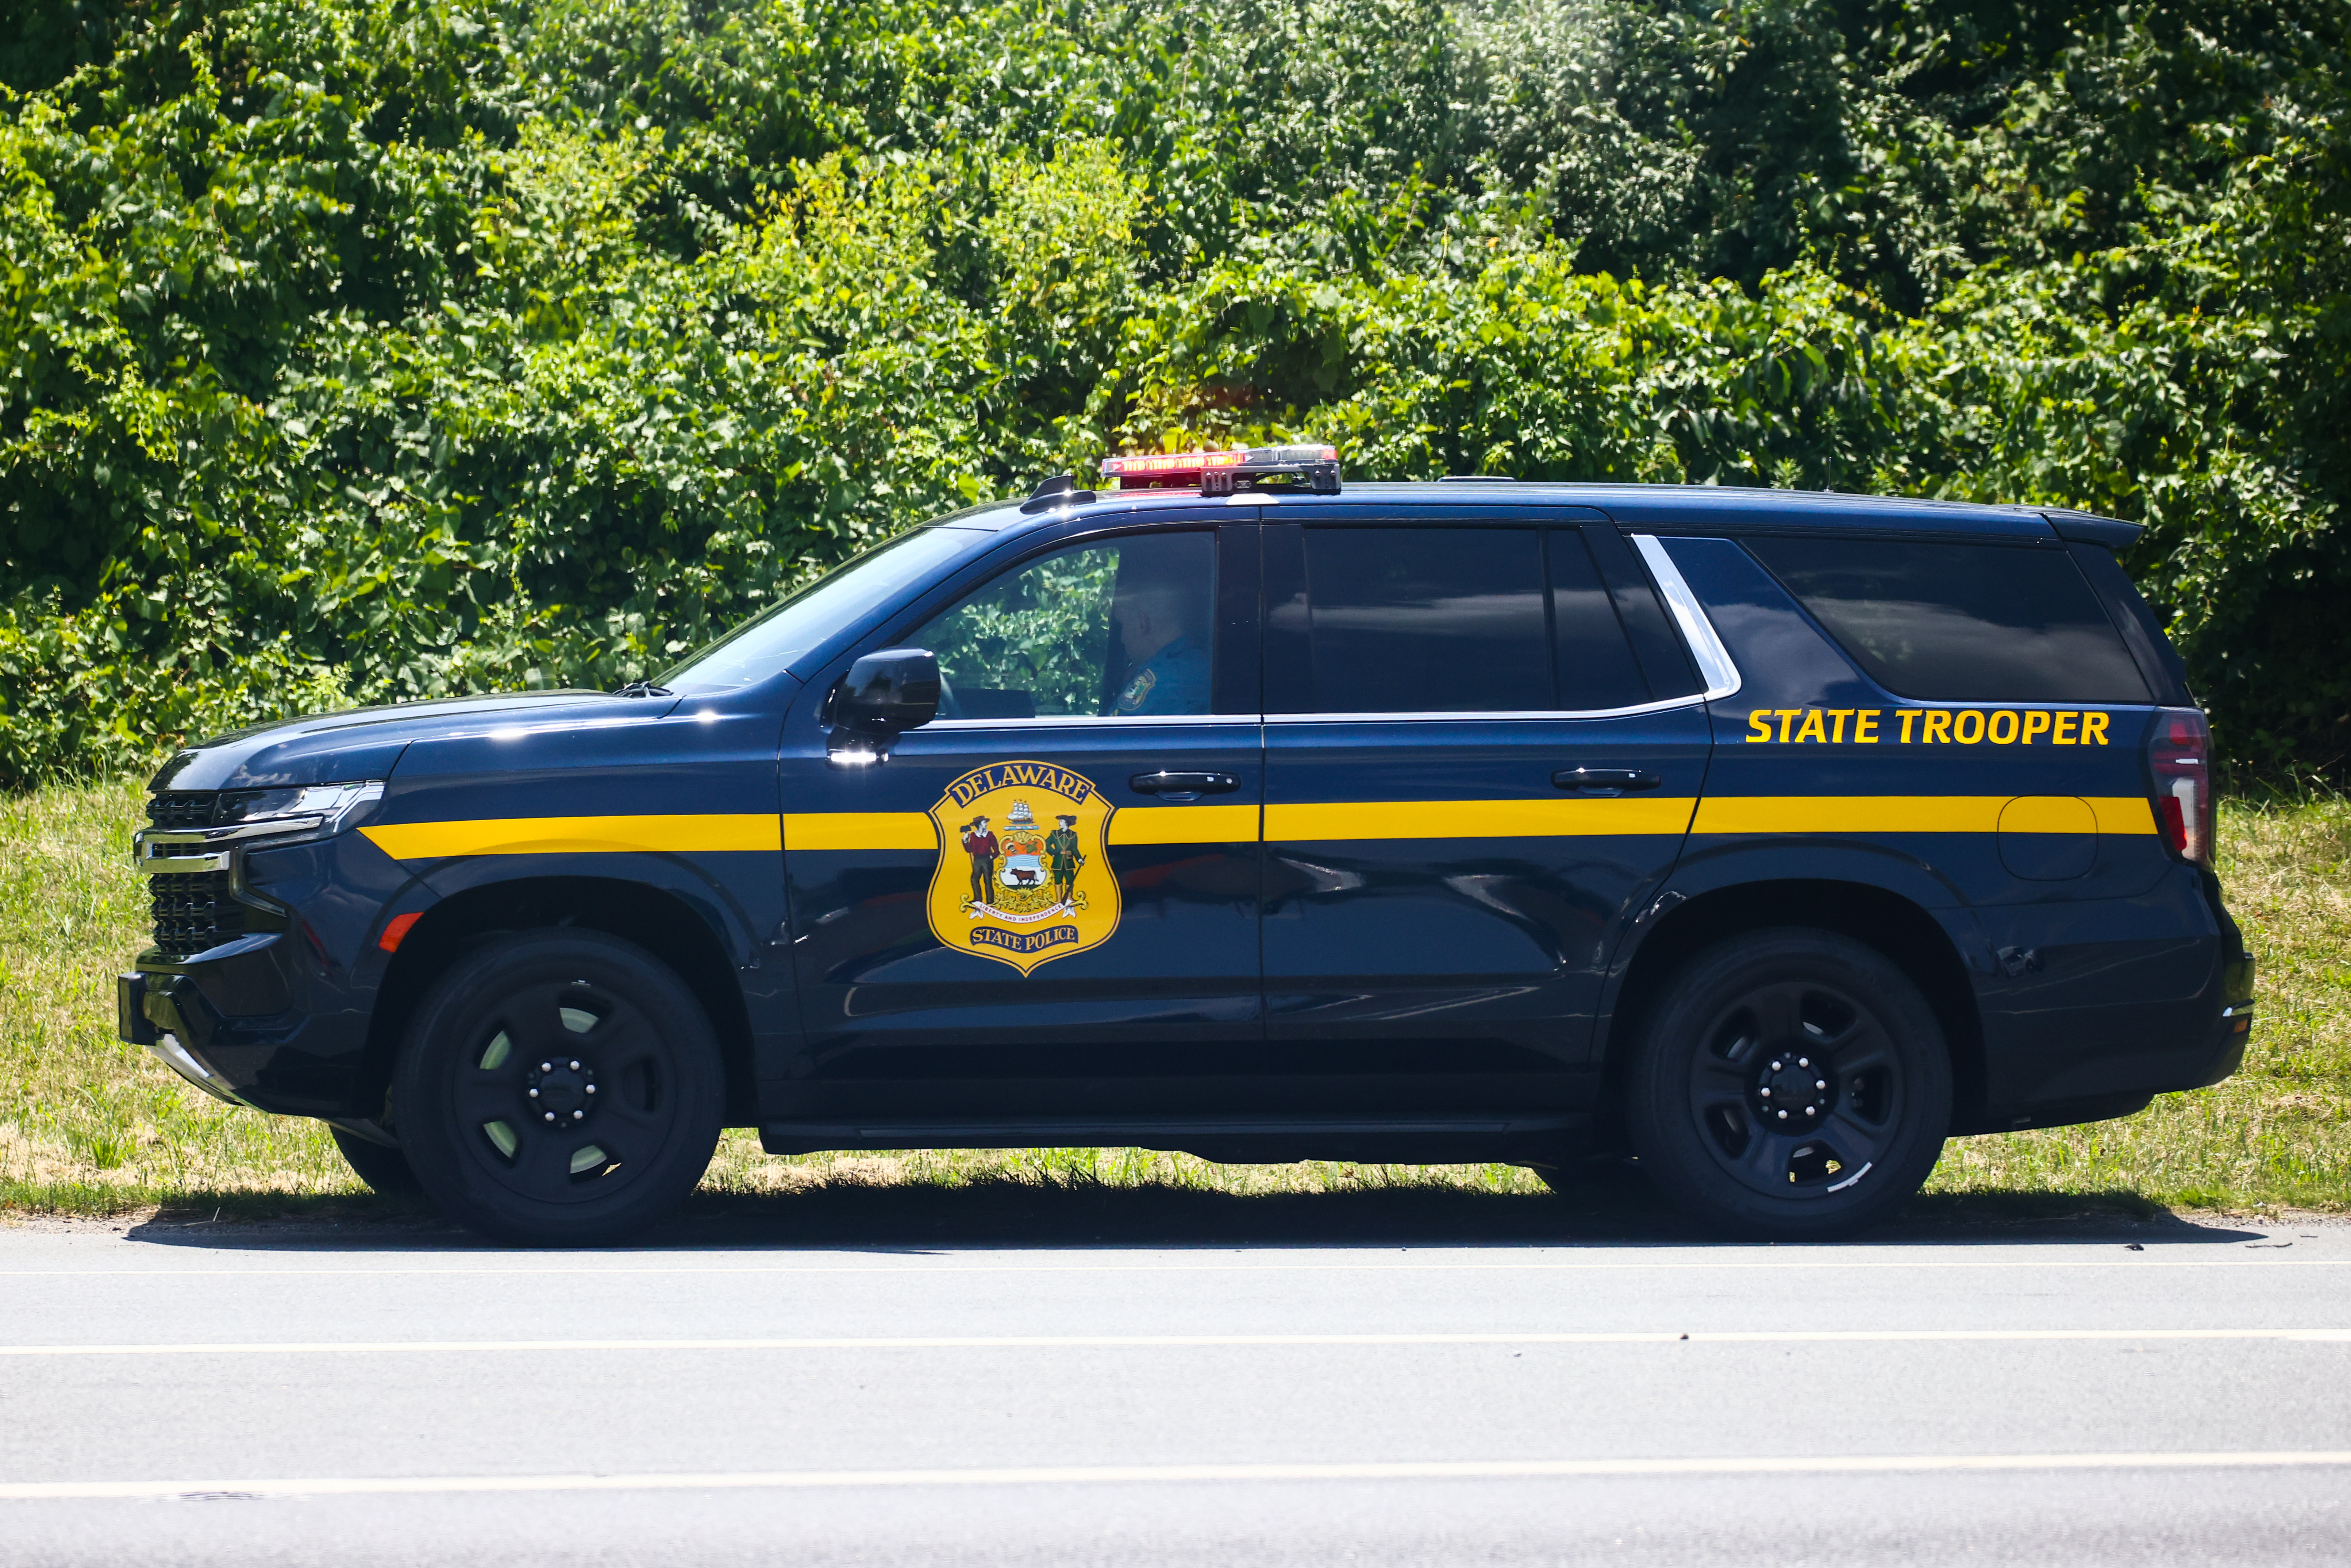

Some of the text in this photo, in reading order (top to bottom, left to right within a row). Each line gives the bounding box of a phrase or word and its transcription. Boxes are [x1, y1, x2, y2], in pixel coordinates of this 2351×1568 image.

[1745, 708, 2109, 745] STATE TROOPER
[952, 766, 1089, 805] DELAWARE
[980, 904, 1003, 917] LIBERTY
[1019, 904, 1062, 921] INDEPENDENCE
[972, 927, 1075, 951] STATE POLICE
